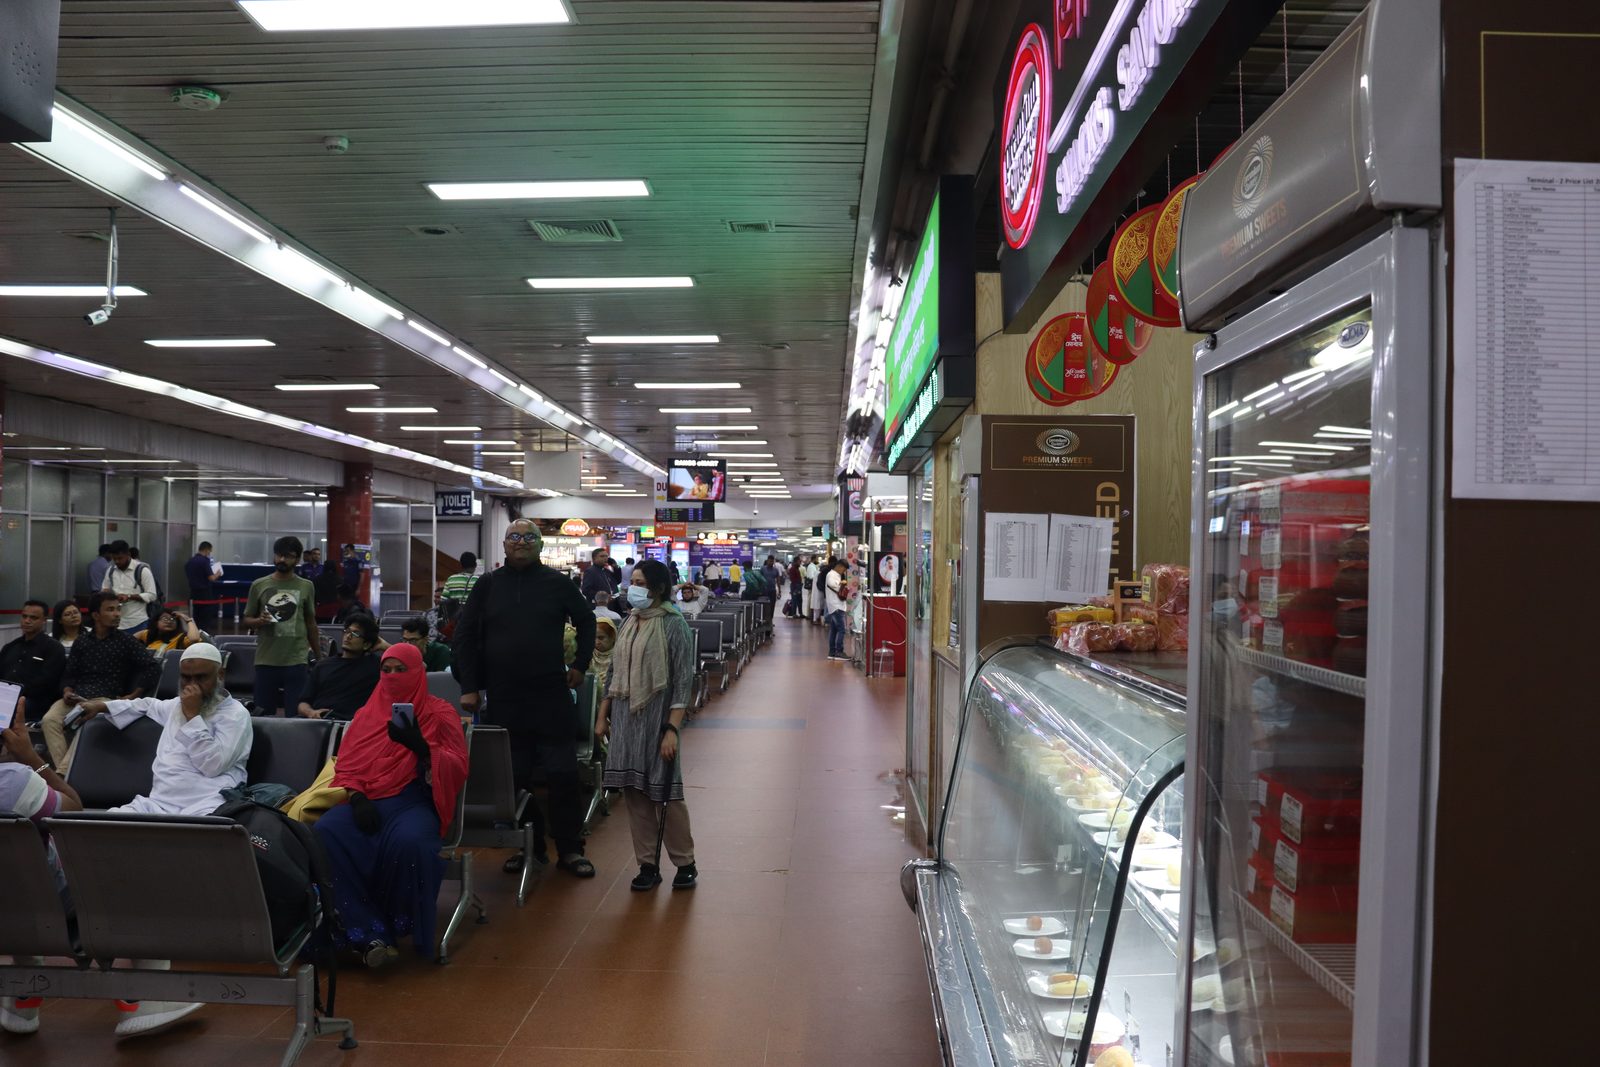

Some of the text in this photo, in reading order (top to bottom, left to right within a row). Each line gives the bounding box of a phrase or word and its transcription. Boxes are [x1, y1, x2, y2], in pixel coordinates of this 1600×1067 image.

[1220, 221, 1253, 258] PREMIUM
[1022, 456, 1093, 464] PREMIUM SWEETS
[656, 482, 667, 491] DU
[444, 495, 470, 507] TOILET
[565, 524, 586, 532] PRAN
